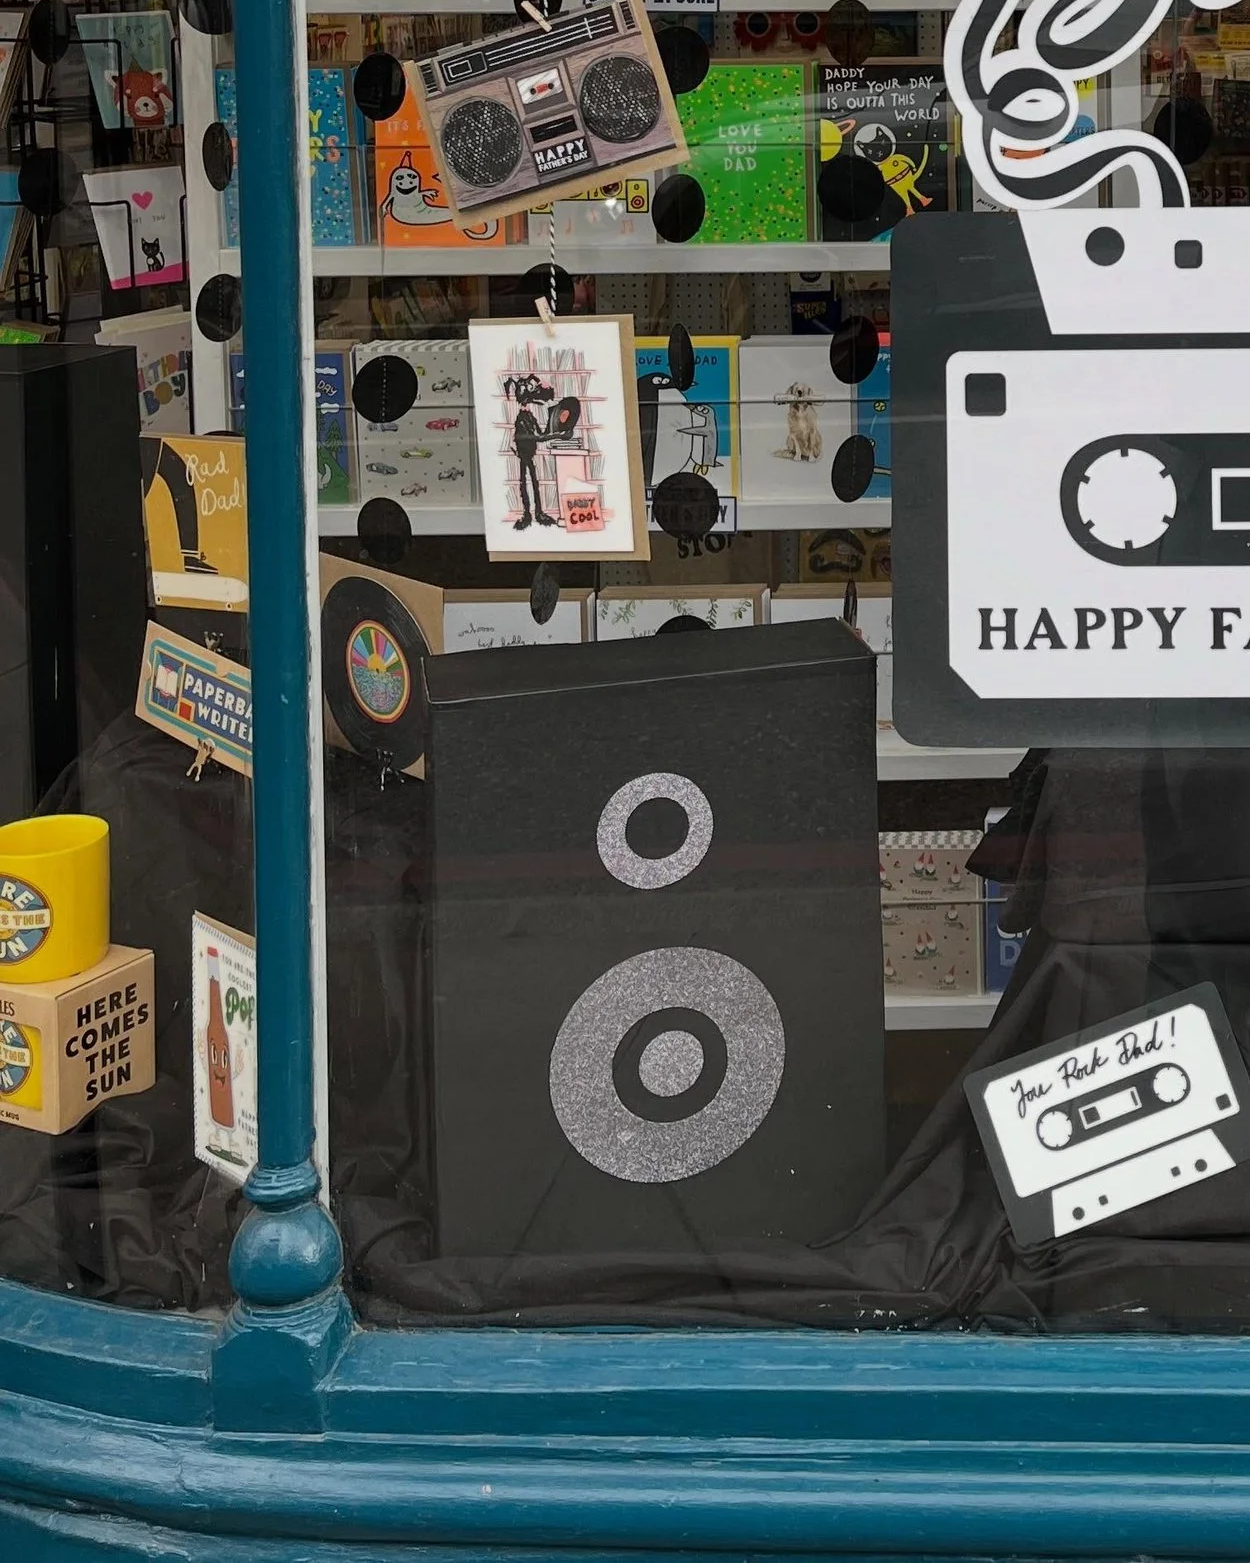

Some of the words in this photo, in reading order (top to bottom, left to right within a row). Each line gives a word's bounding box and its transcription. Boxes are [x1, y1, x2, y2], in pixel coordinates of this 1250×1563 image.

[825, 67, 864, 80] DADDY
[828, 81, 857, 93] HOPE
[866, 79, 901, 93] YOUR
[909, 76, 934, 89] DAY
[827, 98, 838, 110] IS
[846, 95, 885, 109] OUTTA
[891, 93, 915, 106] THIS
[894, 109, 940, 122] WORLD
[719, 124, 762, 138] LOVE
[534, 139, 585, 164] HAPPY
[727, 140, 757, 155] YOU
[538, 155, 573, 173] FATHER'S
[573, 149, 588, 163] DAY
[723, 157, 757, 171] DAD
[636, 356, 661, 367] OVE
[317, 379, 337, 397] DAY
[186, 451, 228, 487] Rad
[570, 510, 599, 525] COOL
[978, 605, 1187, 650] HAPPY
[183, 672, 253, 721] PAPERBA
[12, 913, 46, 927] THE
[77, 982, 138, 1029] HERE
[65, 1003, 149, 1059] COMES
[85, 1036, 131, 1075] THE
[1010, 1079, 1053, 1119] You
[1057, 1047, 1109, 1088] Rock
[1116, 1016, 1176, 1065] Dad!
[86, 1062, 131, 1101] SUN
[5, 1112, 20, 1121] MUG
